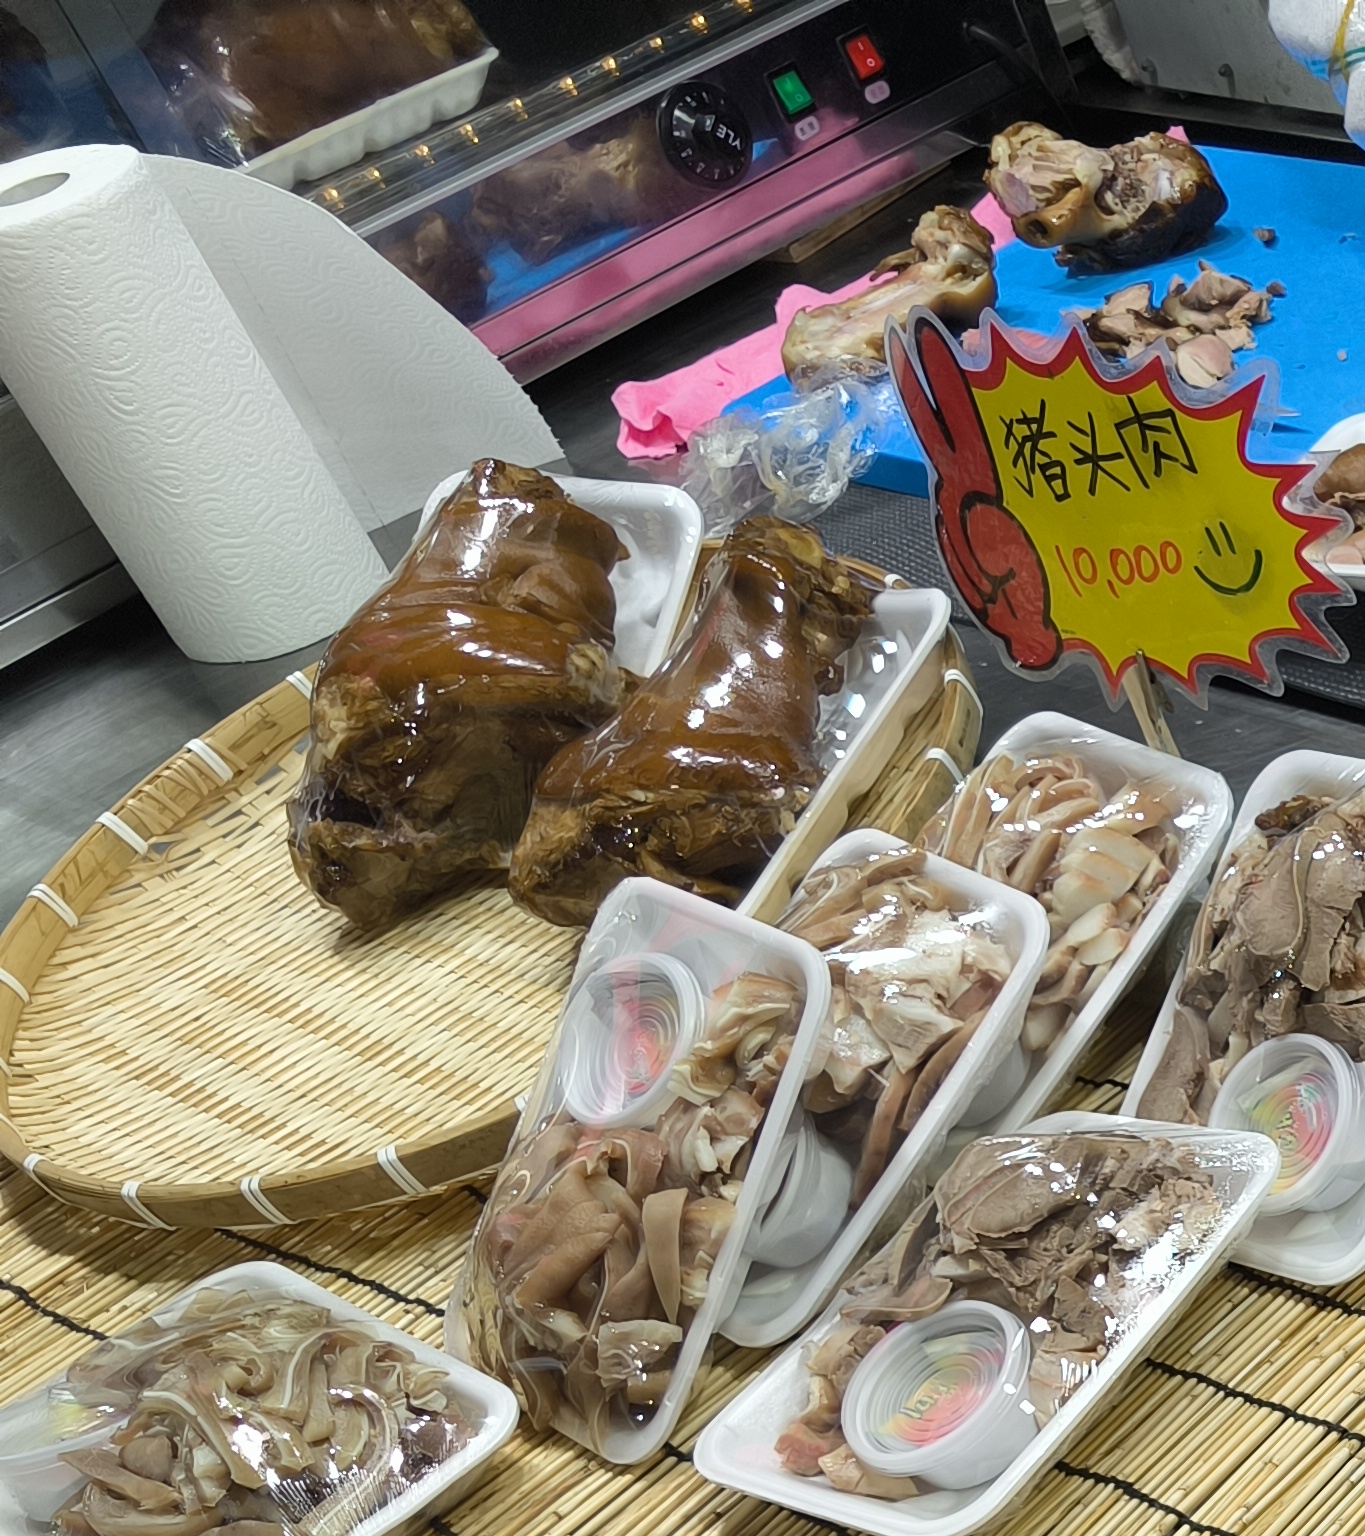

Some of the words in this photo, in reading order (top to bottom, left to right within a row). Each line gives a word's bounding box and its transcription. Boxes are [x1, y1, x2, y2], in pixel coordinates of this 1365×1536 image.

[999, 396, 1198, 502] 猪头肉
[1055, 540, 1183, 598] 10,000
